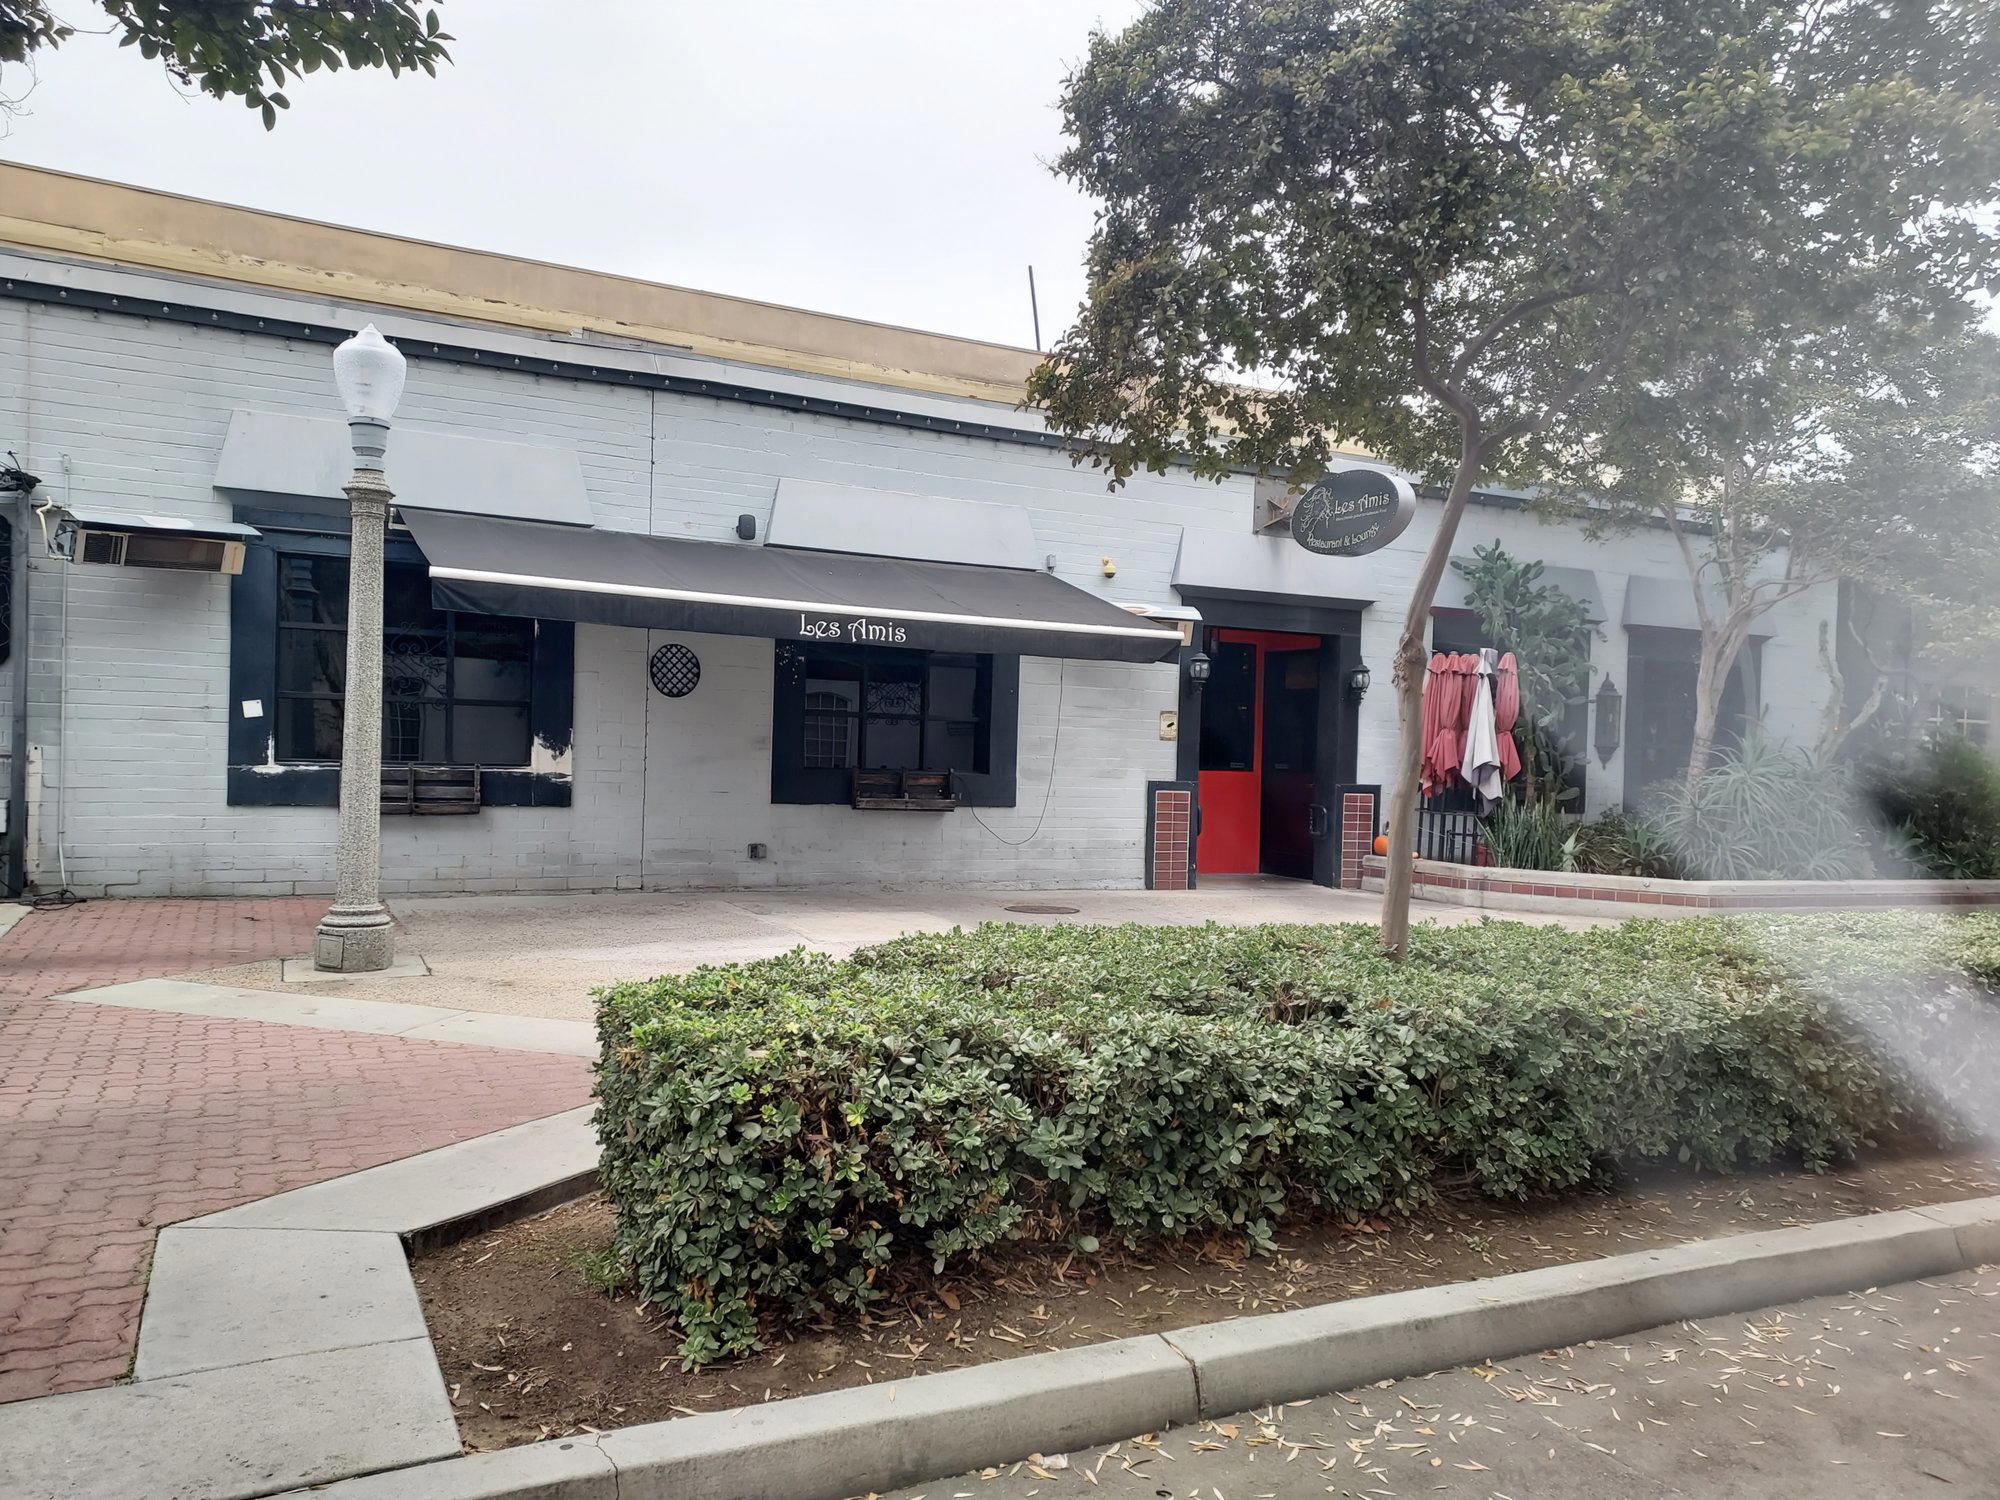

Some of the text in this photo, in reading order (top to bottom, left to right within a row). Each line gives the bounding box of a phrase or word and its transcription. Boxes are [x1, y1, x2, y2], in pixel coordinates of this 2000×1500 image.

[1334, 499, 1355, 515] Les
[1357, 491, 1390, 512] Amis
[1307, 522, 1380, 549] Restaurant & Lounge
[799, 613, 908, 643] Les Amis
